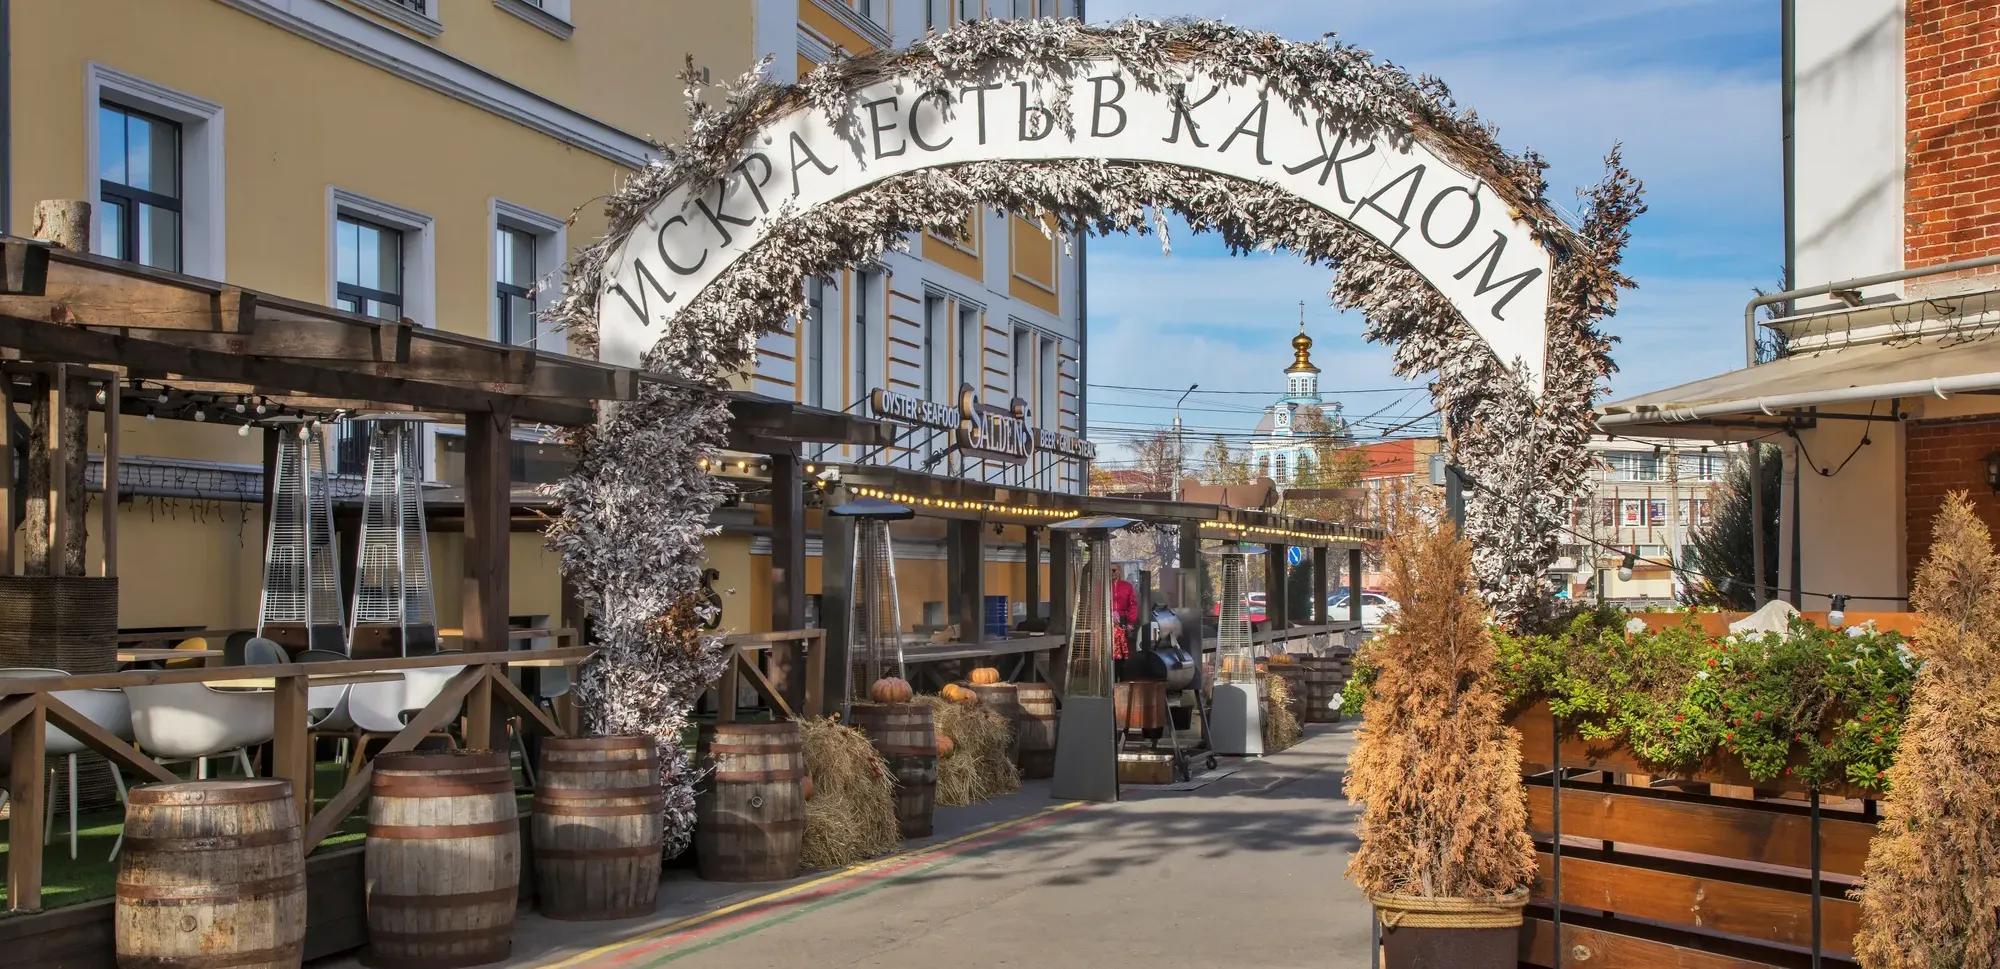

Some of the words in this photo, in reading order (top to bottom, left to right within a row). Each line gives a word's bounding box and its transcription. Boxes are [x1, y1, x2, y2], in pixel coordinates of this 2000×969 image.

[606, 130, 838, 327] ИСКРА
[861, 80, 1055, 161] ЕСТЬ
[1087, 75, 1127, 138] В
[1161, 82, 1543, 322] КАЖДОМ
[882, 390, 918, 420] OYSTER
[921, 401, 960, 429] SEAFOOD
[1040, 429, 1056, 450] BEER
